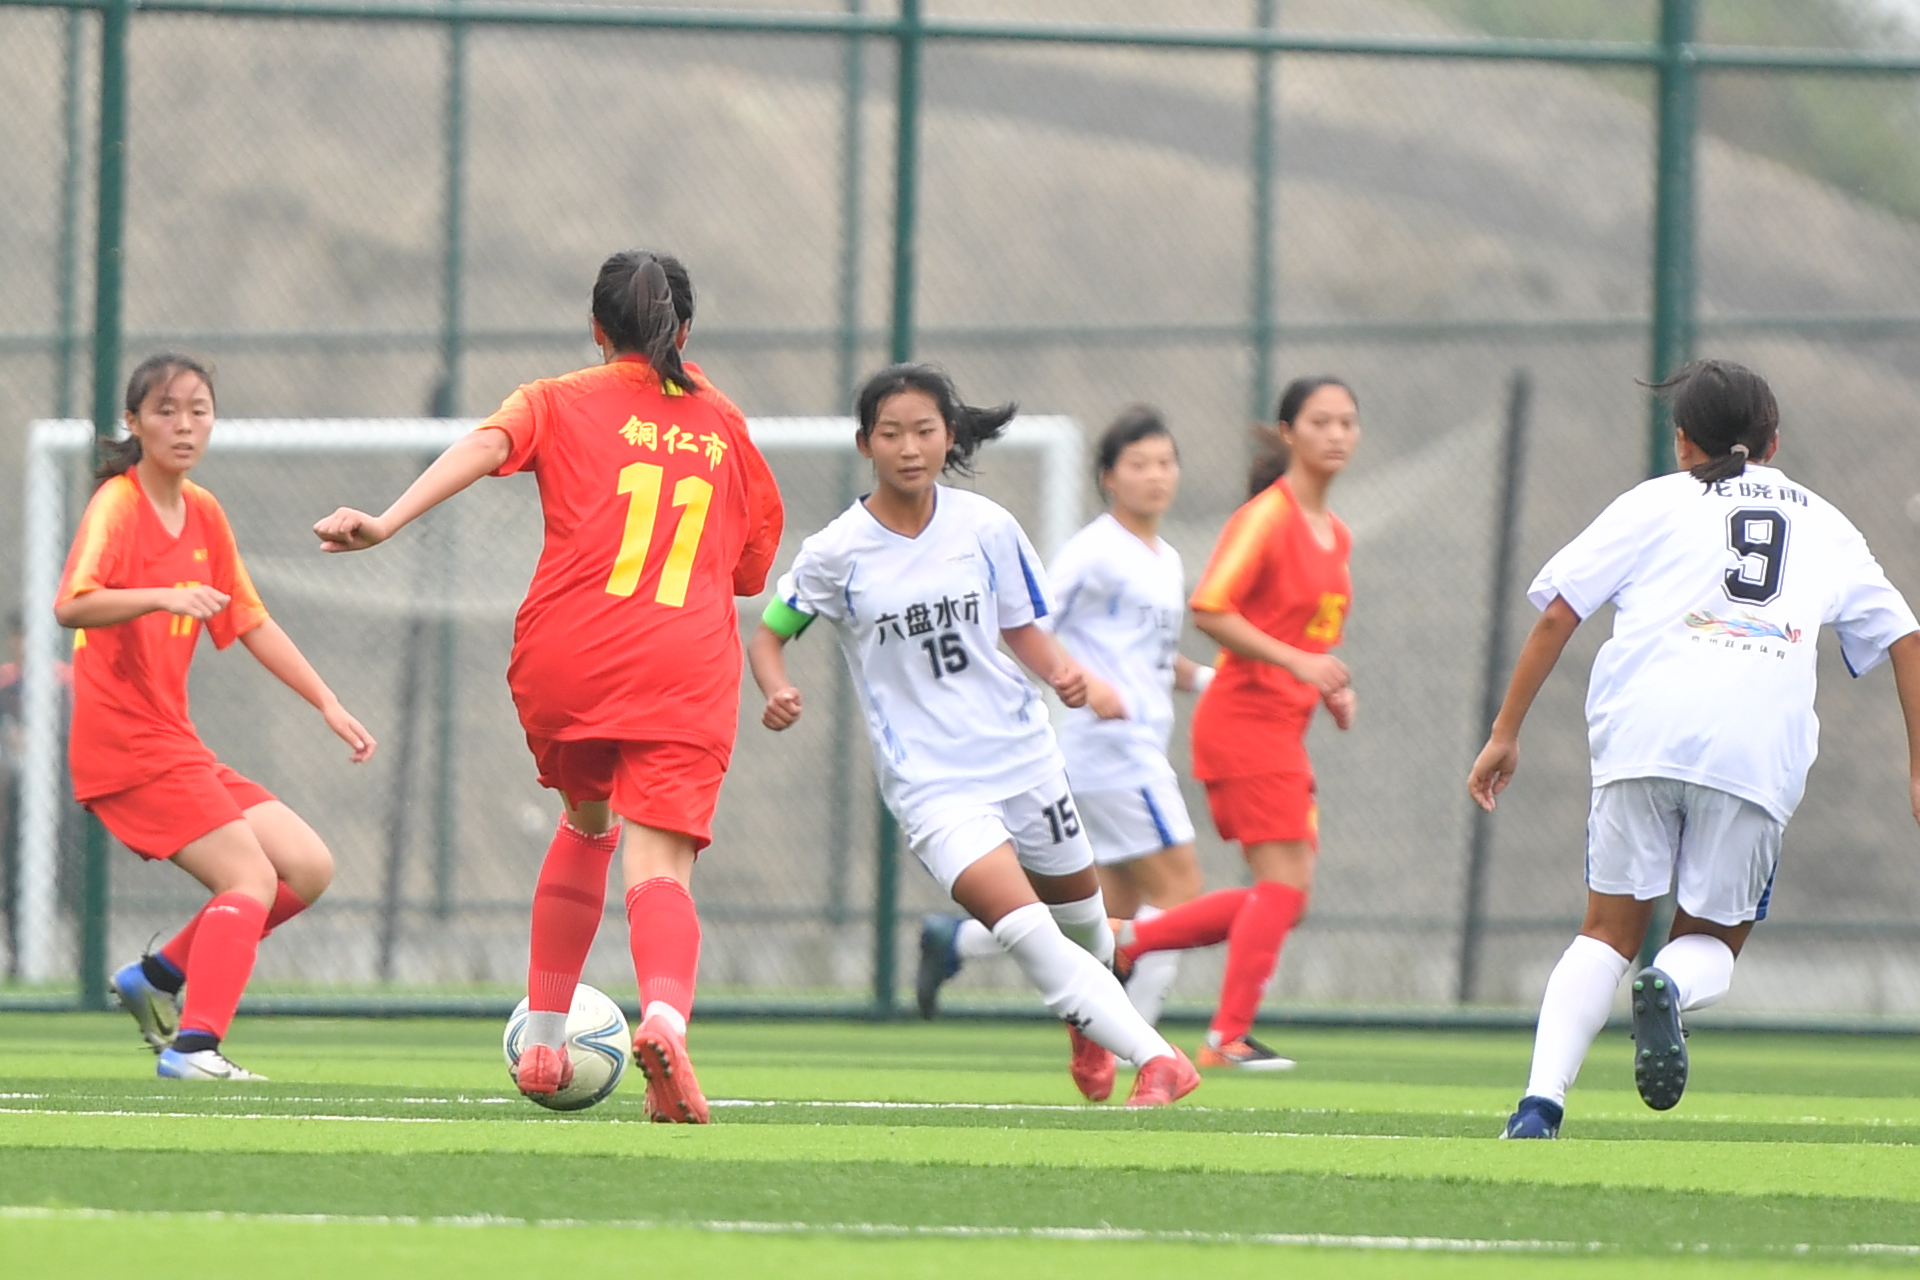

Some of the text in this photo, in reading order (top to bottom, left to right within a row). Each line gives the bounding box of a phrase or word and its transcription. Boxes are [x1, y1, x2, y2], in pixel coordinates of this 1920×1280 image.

[618, 414, 728, 472] 铜仁市
[605, 462, 714, 608] 11
[1721, 506, 1791, 607] 9
[874, 590, 980, 645] 六盘水市
[921, 632, 969, 680] 15
[1042, 793, 1080, 845] 15
